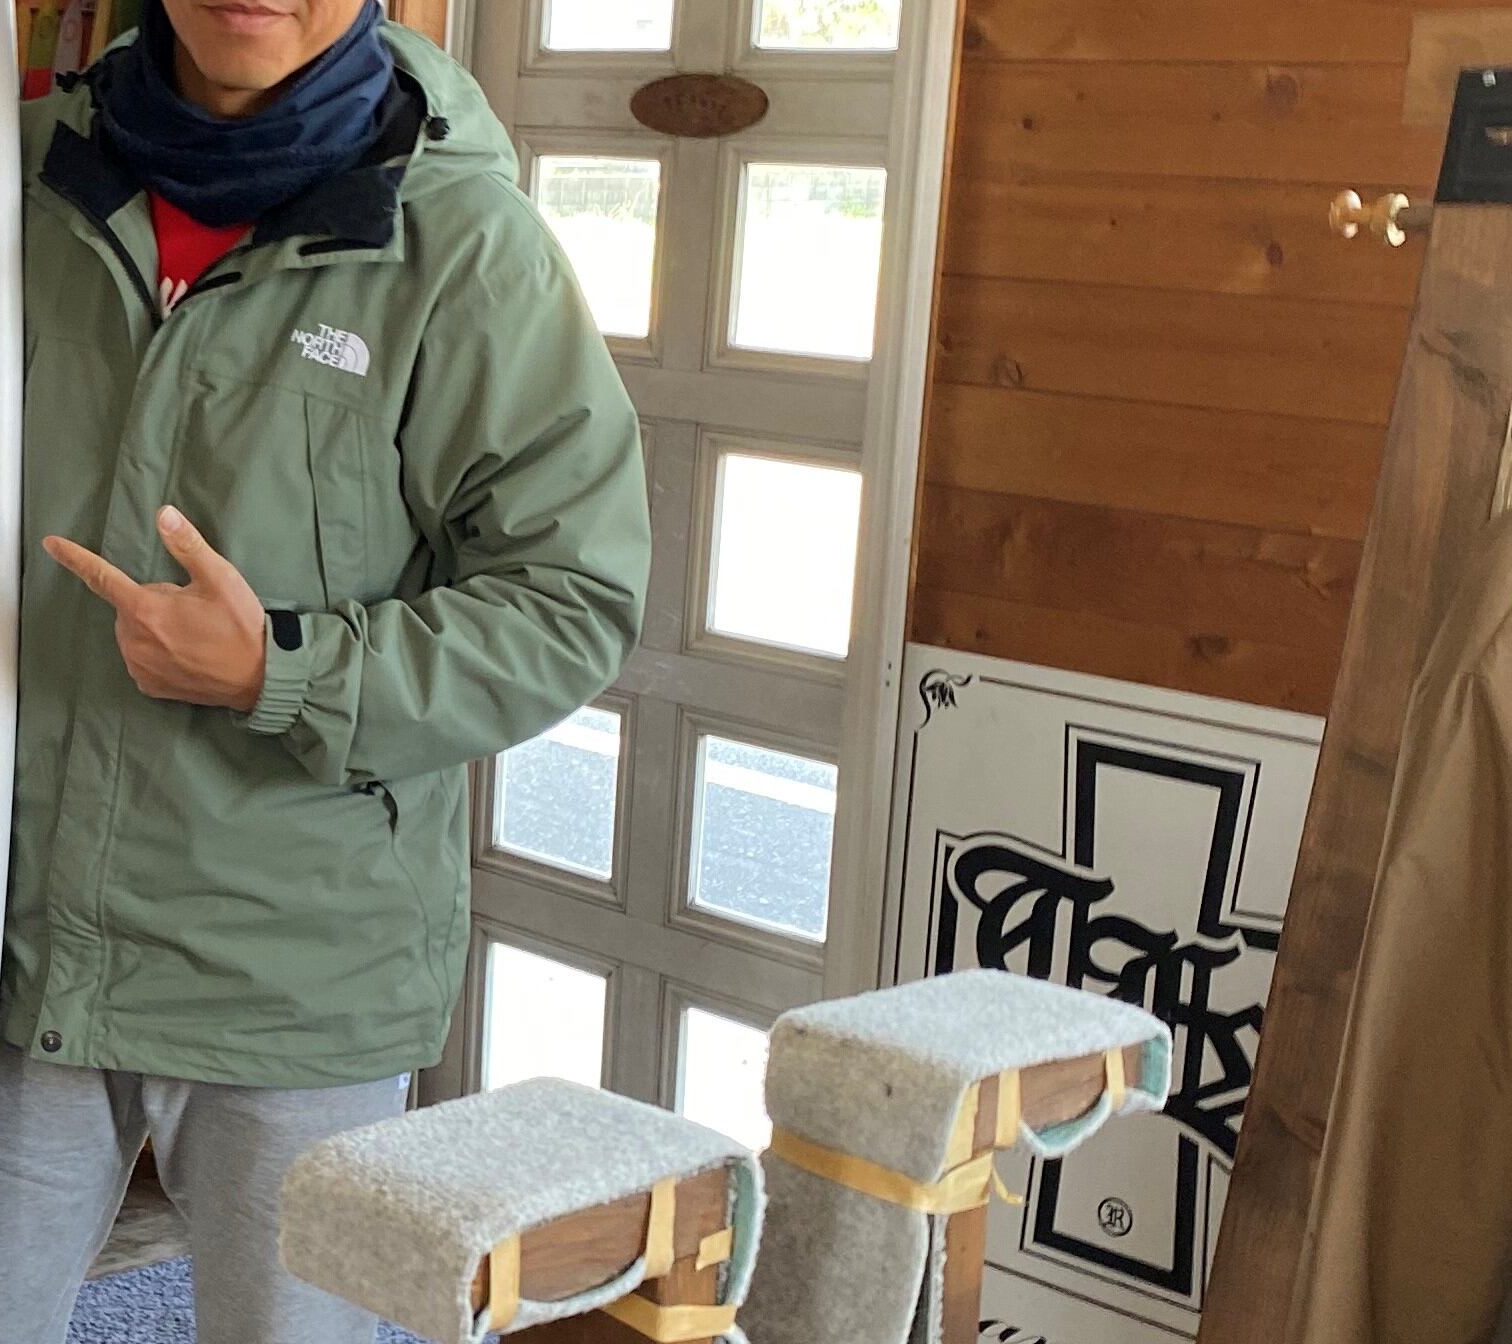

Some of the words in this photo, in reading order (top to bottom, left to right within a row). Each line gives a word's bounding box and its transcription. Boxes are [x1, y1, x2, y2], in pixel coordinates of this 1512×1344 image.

[290, 328, 346, 355] NORTH
[318, 323, 348, 344] THE
[301, 346, 341, 369] FACE
